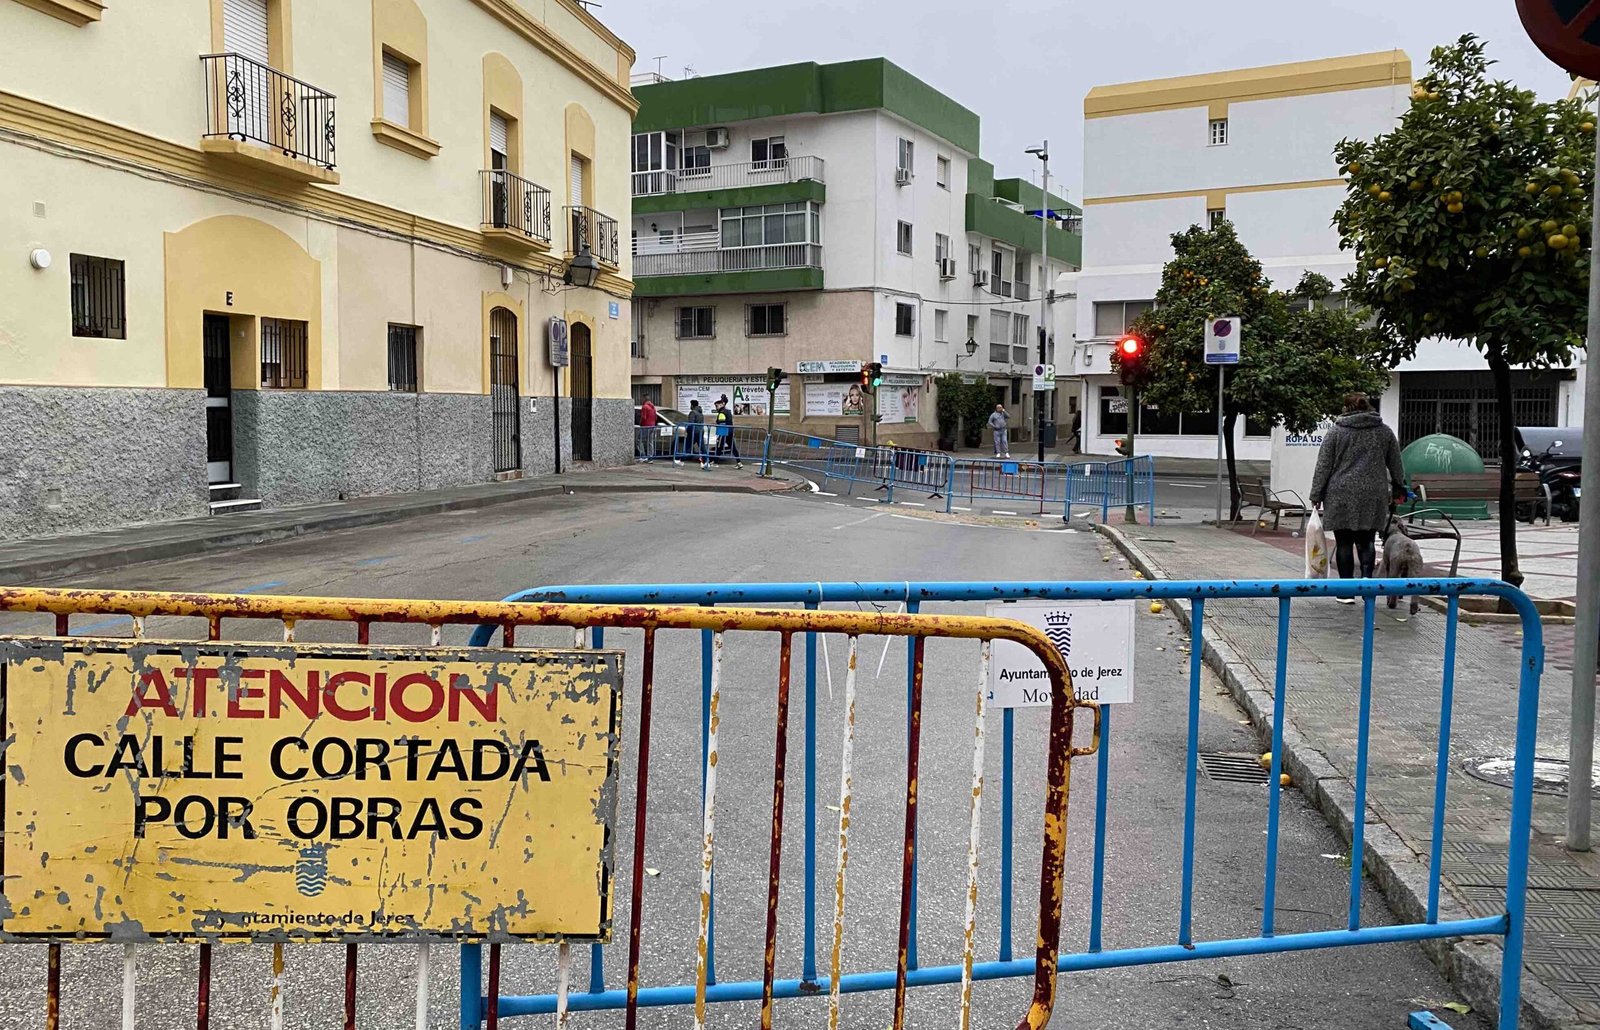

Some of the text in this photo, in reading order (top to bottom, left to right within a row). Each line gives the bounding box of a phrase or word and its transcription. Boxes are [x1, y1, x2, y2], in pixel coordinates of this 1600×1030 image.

[126, 668, 499, 723] ATENCION
[1000, 666, 1122, 682] Ayuntamo de Jerez
[1022, 686, 1099, 703] Modad
[64, 734, 551, 782] CALLE CORTADA
[135, 796, 484, 840] POR OBRAS
